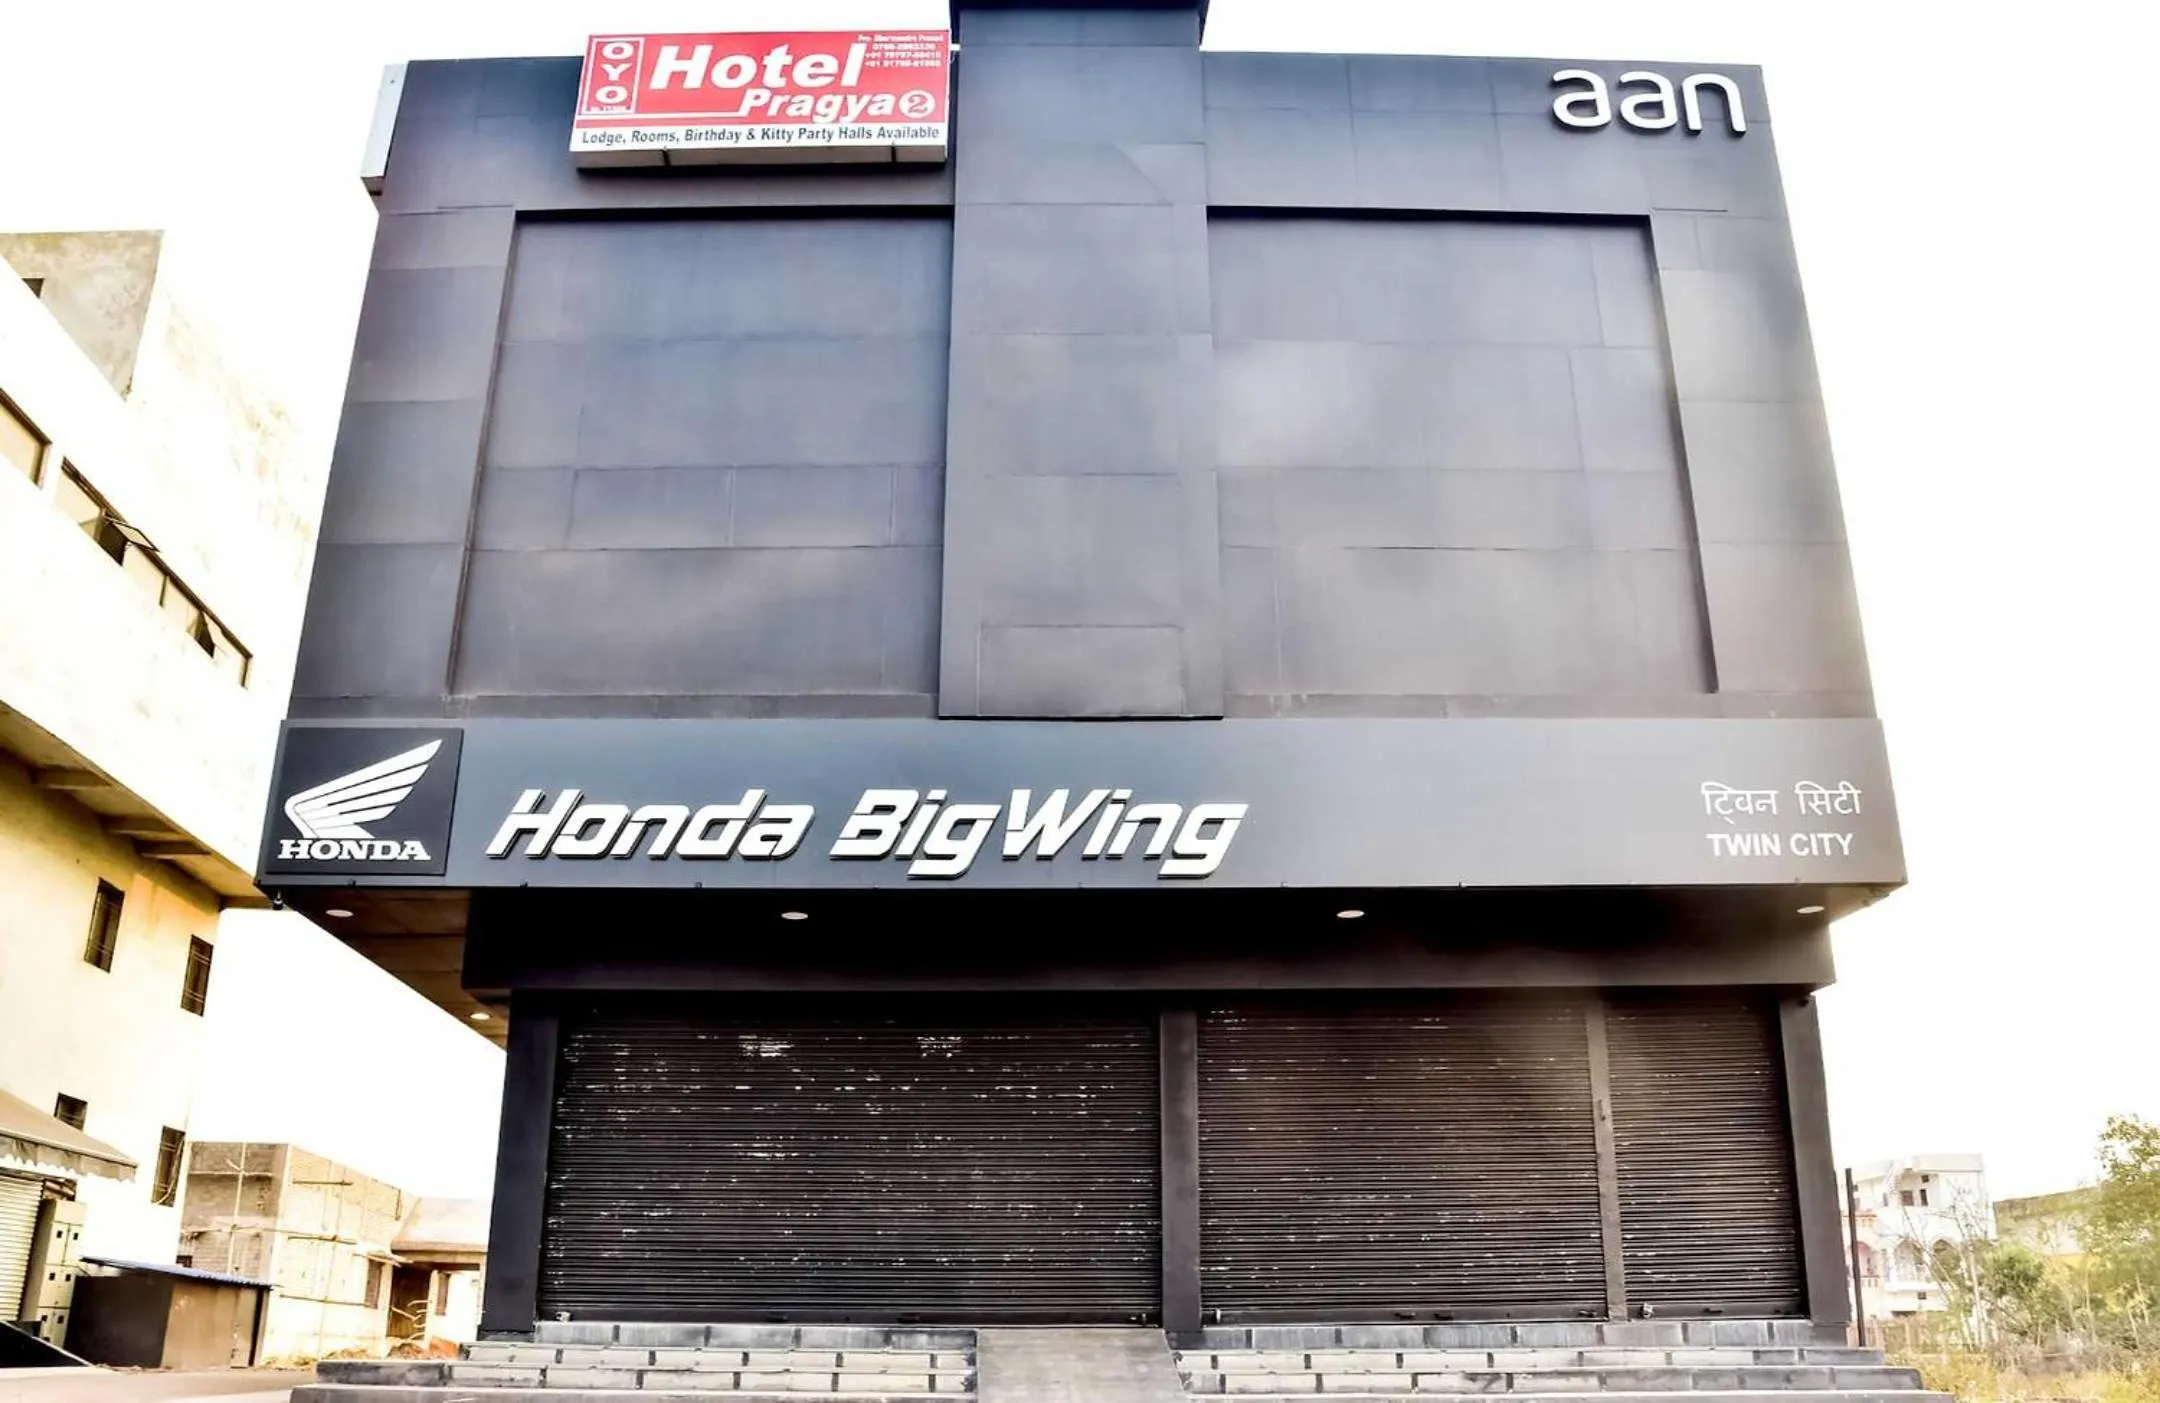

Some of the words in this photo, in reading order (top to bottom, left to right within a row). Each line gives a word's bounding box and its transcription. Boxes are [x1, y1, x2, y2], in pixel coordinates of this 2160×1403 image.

[595, 41, 634, 104] OYO
[649, 43, 867, 90] Hotel
[739, 88, 896, 124] Pragya
[905, 93, 930, 115] 2
[1551, 69, 1747, 135] aan
[581, 131, 627, 146] Lodge,
[631, 129, 681, 144] Rooms,
[684, 128, 742, 144] Birthday
[746, 127, 757, 141] &
[760, 127, 794, 143] Kitty
[798, 126, 834, 142] Party
[838, 126, 873, 140] Halls
[876, 125, 940, 140] Available
[1794, 780, 1862, 816] सिटी
[485, 789, 816, 861] Honda
[276, 838, 431, 862] HONDA
[1705, 832, 1782, 857] TWIN
[1789, 832, 1854, 857] CITY
